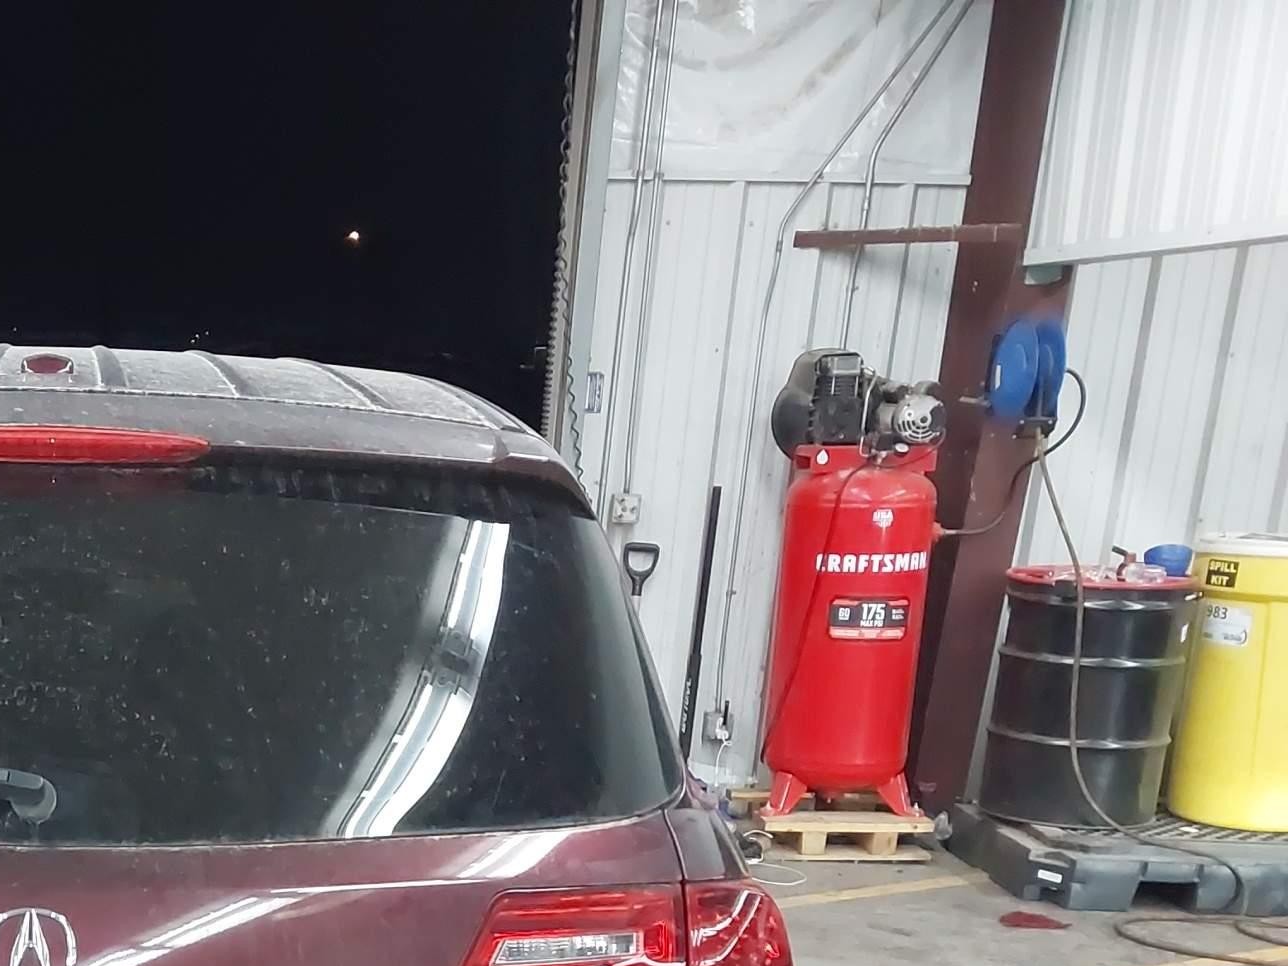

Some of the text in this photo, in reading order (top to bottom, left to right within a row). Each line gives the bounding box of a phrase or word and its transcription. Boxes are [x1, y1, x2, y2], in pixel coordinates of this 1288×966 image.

[816, 552, 927, 573] CRAFTSMAN
[1209, 561, 1237, 573] SPILL
[1210, 575, 1230, 586] KIT
[862, 603, 886, 620] 175
